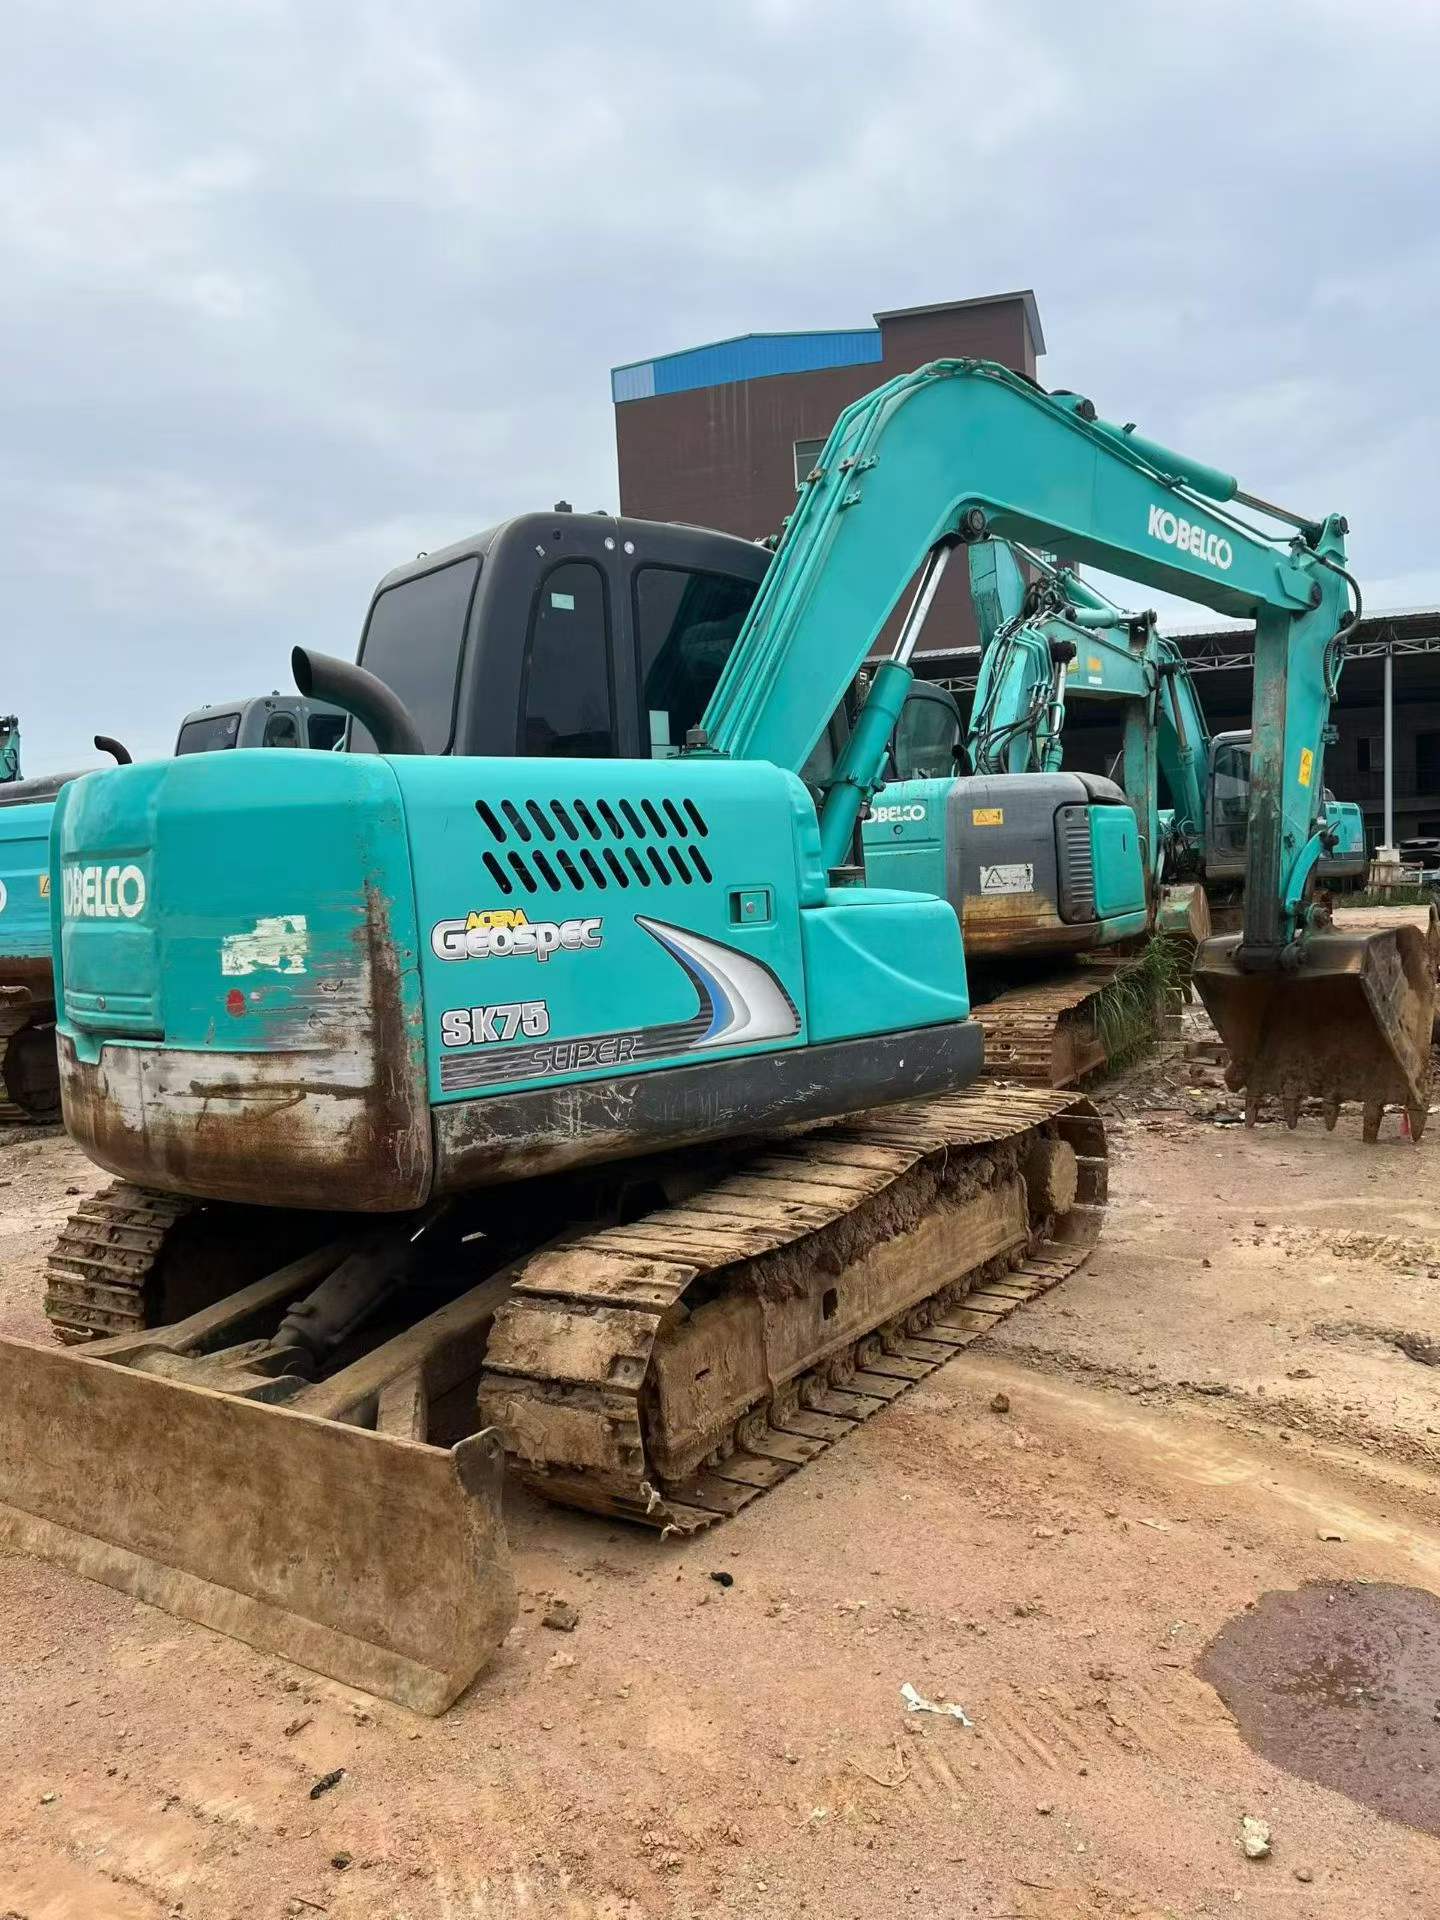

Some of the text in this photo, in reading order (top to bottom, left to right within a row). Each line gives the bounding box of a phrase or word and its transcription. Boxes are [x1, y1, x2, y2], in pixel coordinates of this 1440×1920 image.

[1148, 503, 1232, 570] KOBELCO
[862, 804, 926, 824] OBELCO
[62, 864, 146, 918] OBELCO
[464, 908, 530, 930] ACERA
[440, 1000, 550, 1047] SK75
[527, 1036, 636, 1076] SUPER
